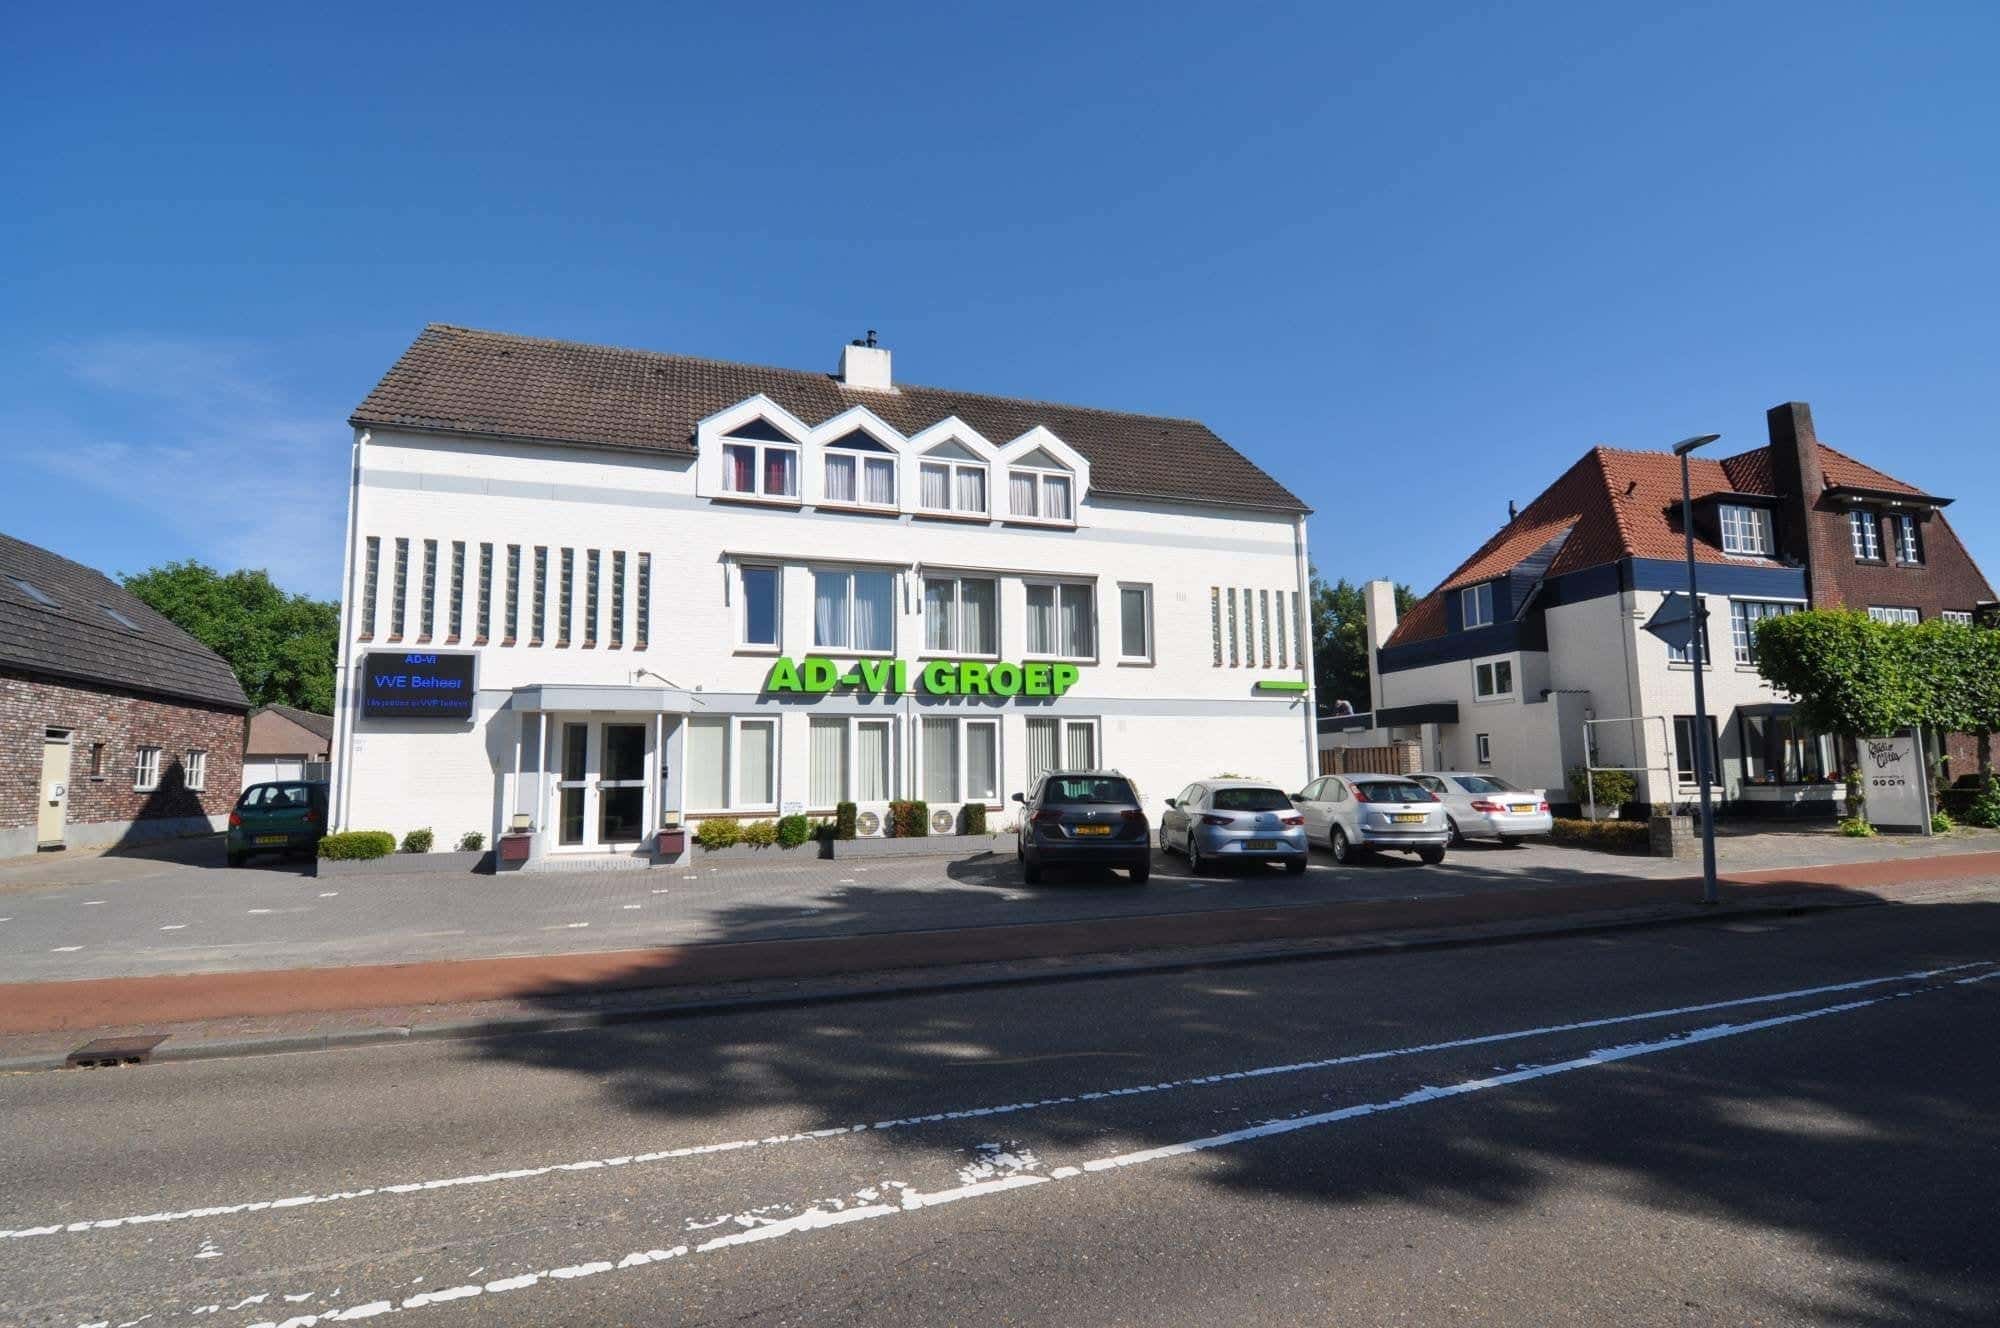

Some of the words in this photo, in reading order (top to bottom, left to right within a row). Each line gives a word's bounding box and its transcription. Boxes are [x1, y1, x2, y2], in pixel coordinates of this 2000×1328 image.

[375, 675, 408, 688] VVE
[411, 675, 463, 689] Beheer
[767, 656, 907, 693] AD-VI
[923, 660, 1080, 697] GROEP
